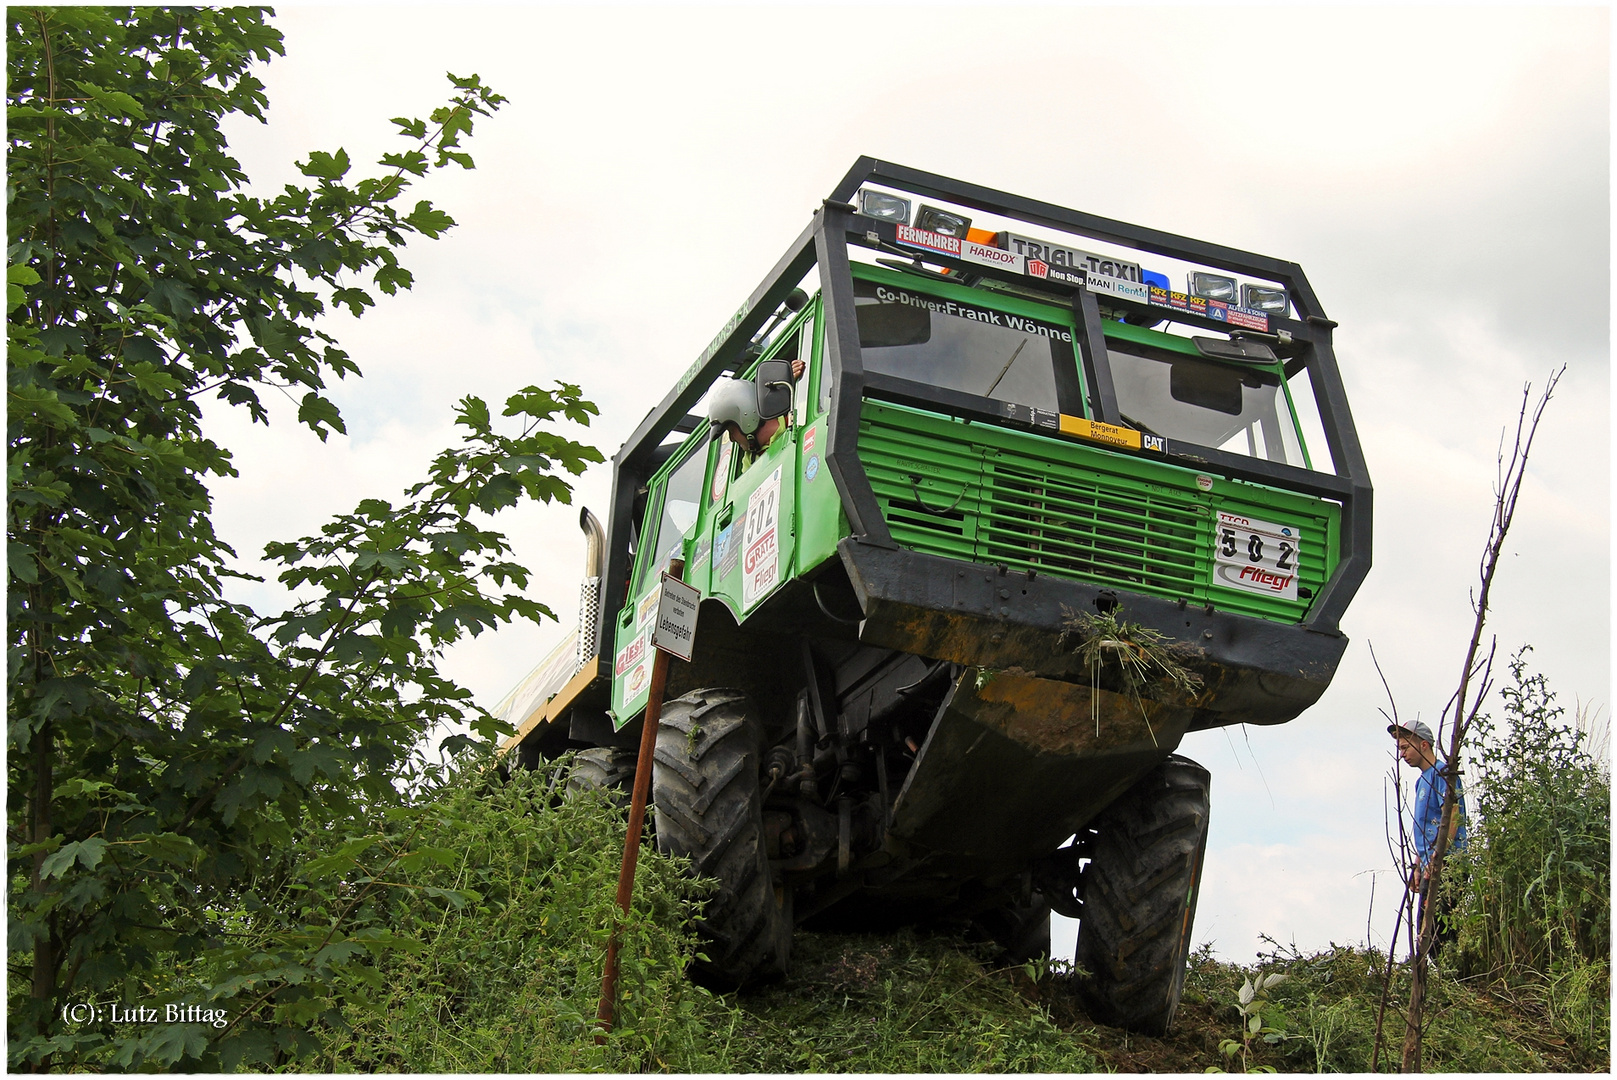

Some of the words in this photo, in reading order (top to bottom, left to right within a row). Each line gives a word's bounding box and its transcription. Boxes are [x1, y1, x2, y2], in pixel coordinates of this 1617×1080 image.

[898, 225, 960, 253] FERNFAHRER
[969, 245, 1016, 264] HARDOX
[1013, 238, 1136, 282] TRIAL-TAXI
[1029, 261, 1046, 277] UTA
[1050, 269, 1065, 280] Non
[1066, 272, 1086, 286] Stop.
[1087, 276, 1110, 289] MAN
[1117, 284, 1147, 298] Rental
[1150, 286, 1167, 297] KFZ
[1170, 291, 1187, 301] KFZ
[1190, 296, 1206, 306] KFZ
[1005, 313, 1072, 343] Wönne
[1090, 421, 1119, 435] Bergerat
[1091, 430, 1128, 446] Monnoyeur
[1144, 434, 1164, 452] CAT
[747, 490, 775, 544] 502
[754, 556, 777, 592] Fliegl
[1240, 565, 1294, 591] Fliegl
[659, 614, 692, 642] Lebensgefahr
